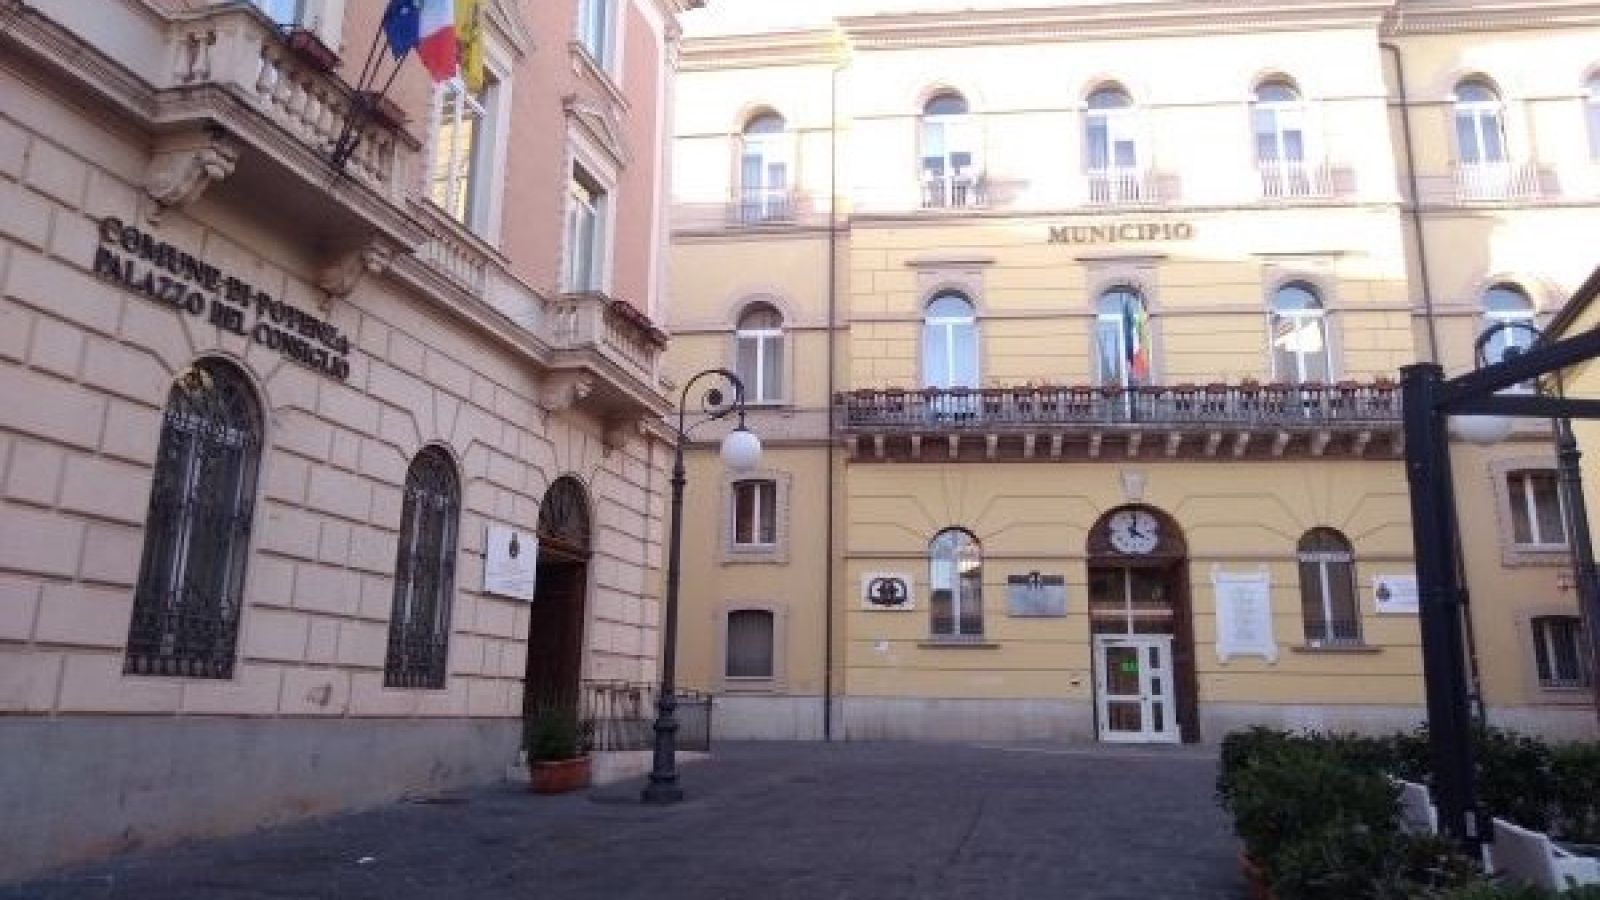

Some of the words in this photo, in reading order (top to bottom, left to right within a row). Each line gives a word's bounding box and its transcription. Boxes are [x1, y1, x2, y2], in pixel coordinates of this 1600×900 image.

[99, 217, 221, 291] COMUNE
[225, 276, 251, 307] DI
[1047, 223, 1193, 245] MUNICIPIO
[94, 246, 205, 315] PALAZZO
[208, 300, 249, 335] DEL
[252, 322, 349, 380] CONSIGLIO
